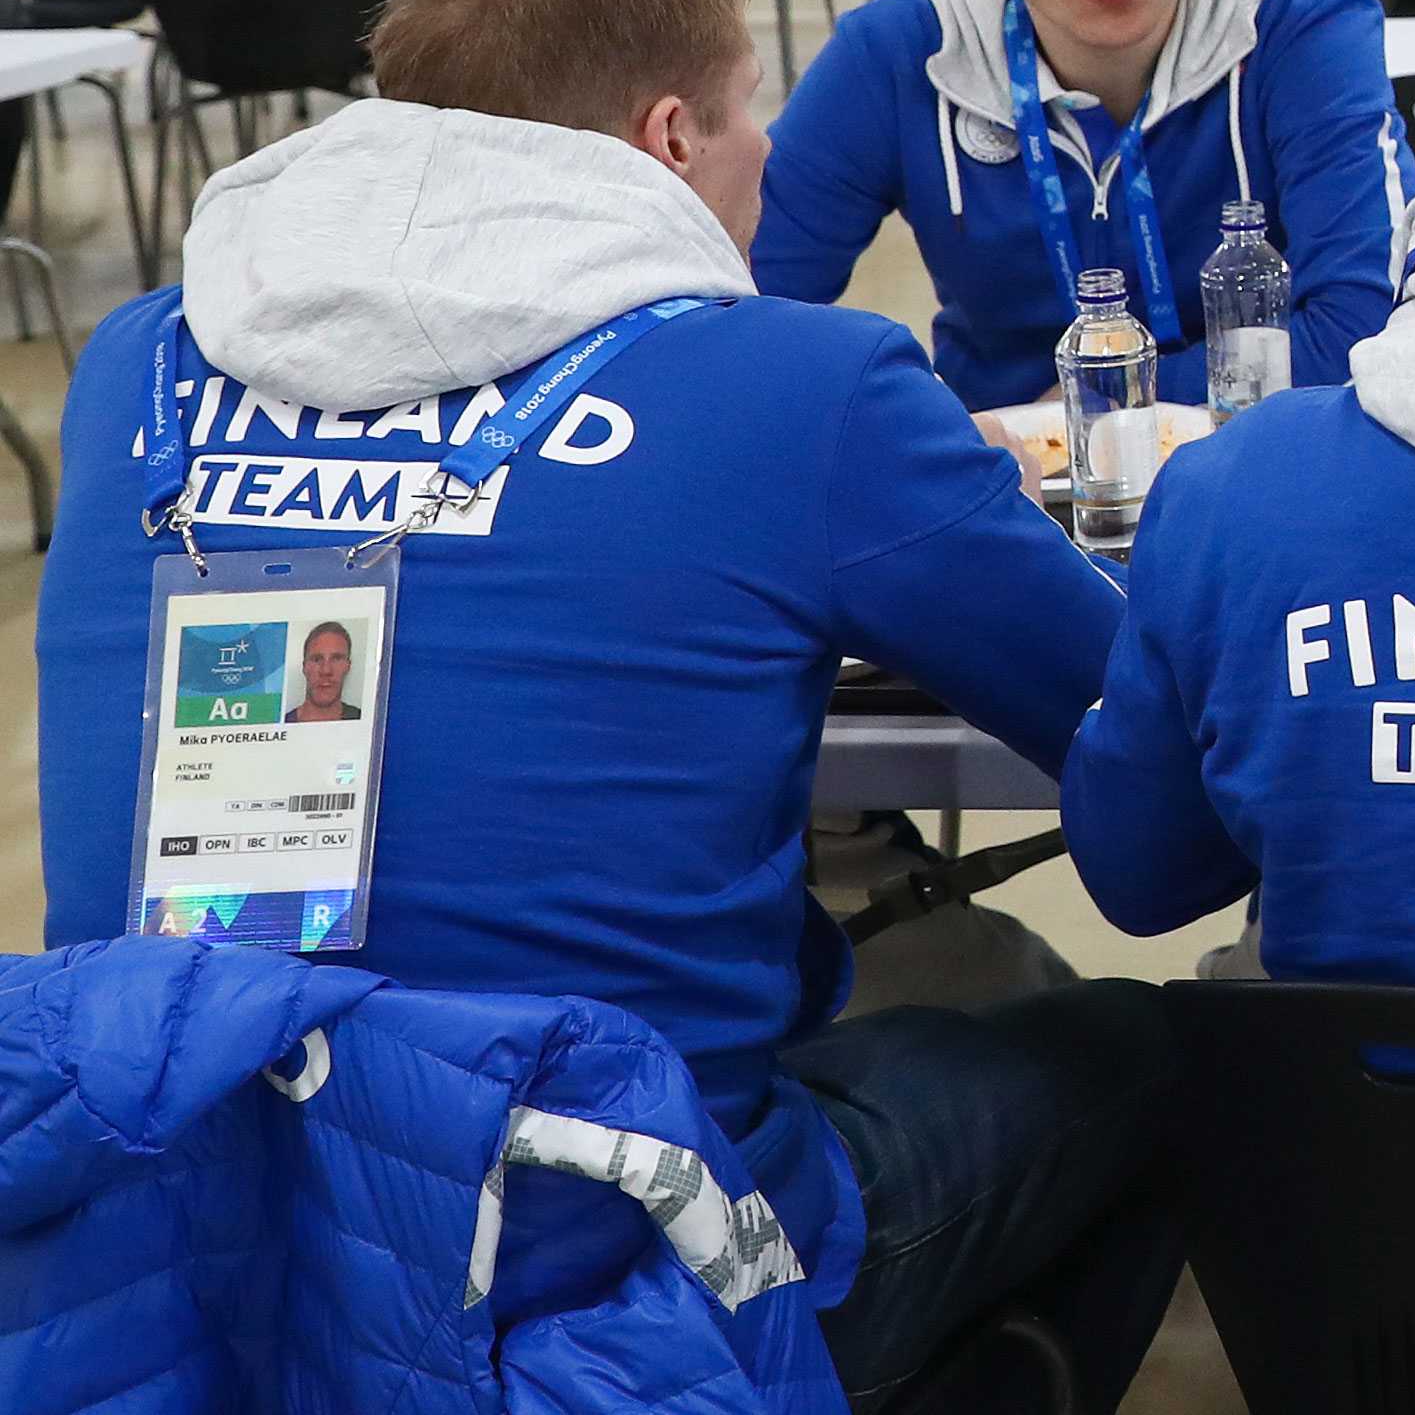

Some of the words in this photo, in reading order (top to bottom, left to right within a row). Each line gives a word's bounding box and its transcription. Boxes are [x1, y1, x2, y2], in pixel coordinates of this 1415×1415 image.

[538, 330, 617, 395] PyeongChang
[514, 392, 546, 421] 2018
[194, 461, 402, 523] TEAM
[208, 697, 249, 721] Aa
[179, 735, 208, 746] Mika
[210, 731, 287, 744] PYOERAELAE
[175, 773, 211, 783] FINLAND
[176, 762, 213, 772] ATHLETE
[205, 839, 231, 850] OPN
[247, 836, 267, 849] IBC
[282, 835, 309, 846] MPC
[321, 833, 347, 845] OLV
[313, 904, 330, 928] R
